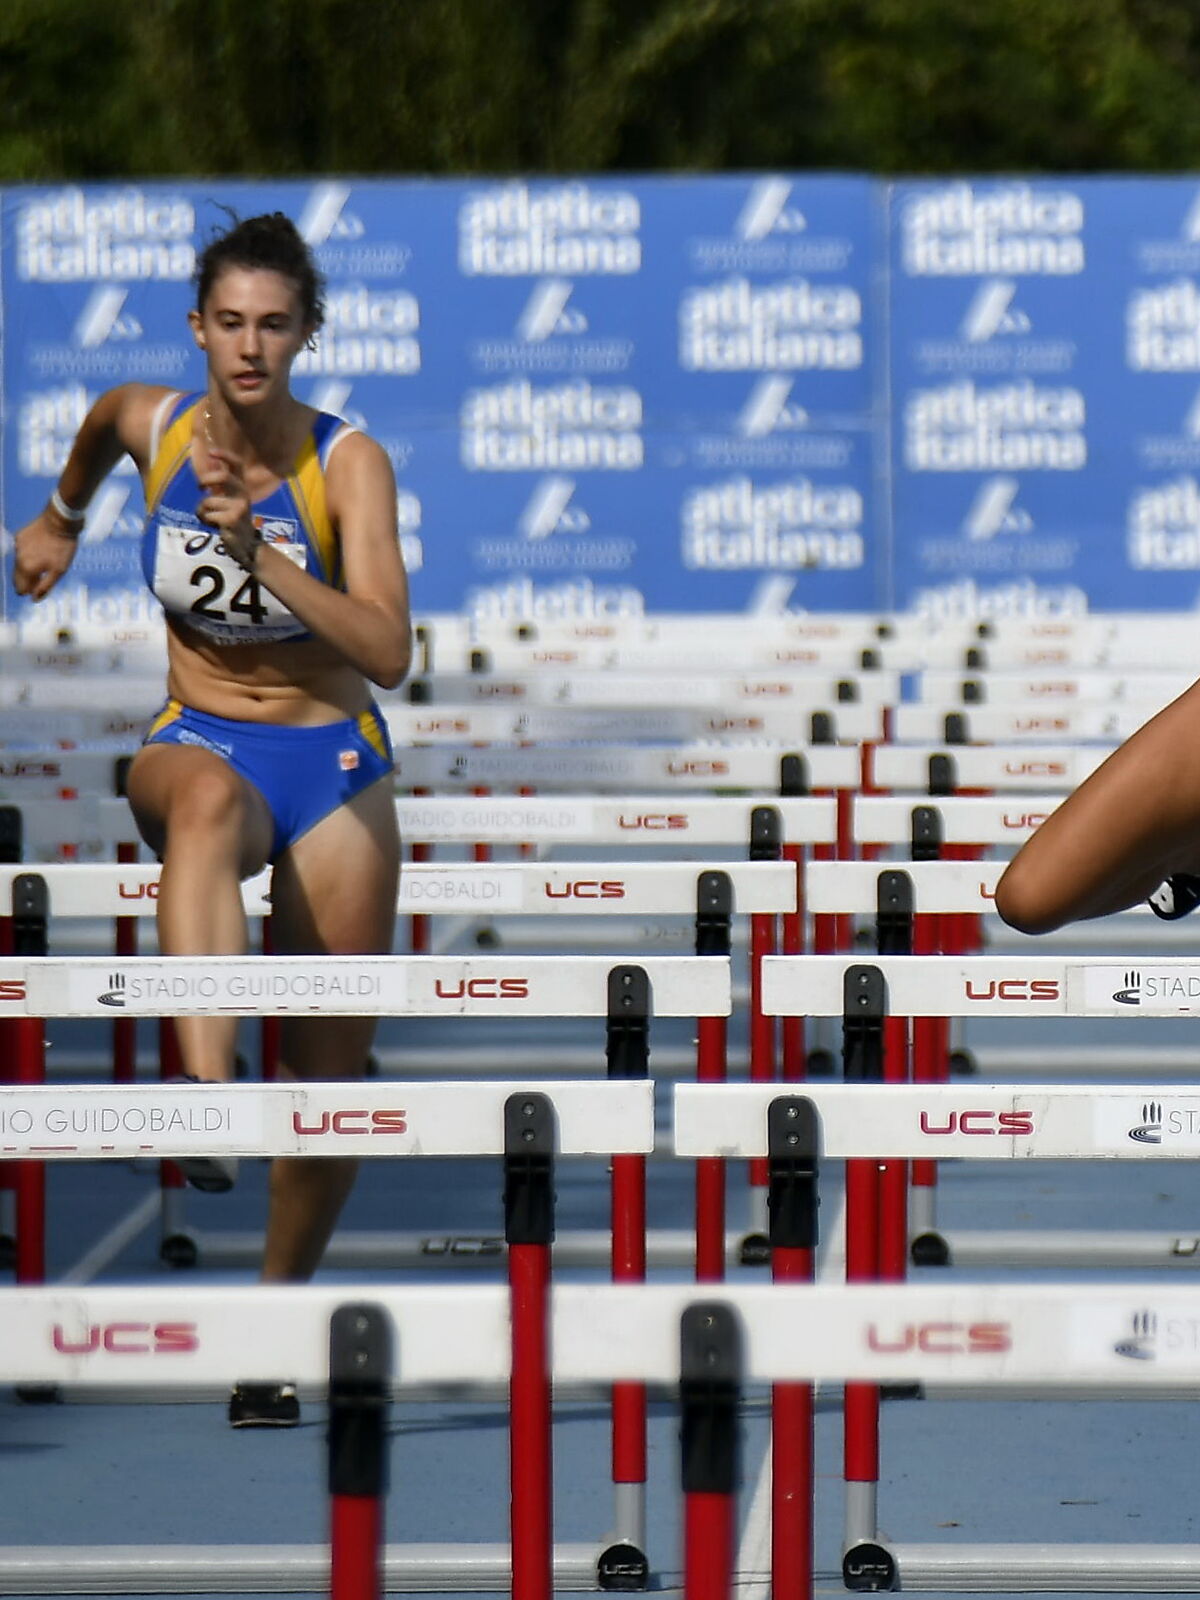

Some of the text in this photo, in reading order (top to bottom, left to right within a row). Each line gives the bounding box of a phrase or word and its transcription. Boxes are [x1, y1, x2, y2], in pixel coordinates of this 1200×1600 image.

[25, 188, 195, 237] atletica
[467, 183, 641, 232] atletica
[911, 181, 1084, 230] atletica
[26, 230, 195, 279] italiana
[468, 225, 641, 273] italiana
[912, 223, 1084, 273] italiana
[690, 276, 861, 325] atletica
[691, 318, 861, 368] italiana
[469, 378, 643, 427] atletica
[914, 378, 1086, 427] atletica
[470, 420, 643, 468] italiana
[915, 420, 1086, 468] italiana
[691, 476, 863, 525] atletica
[692, 518, 863, 567] italiana
[190, 565, 269, 625] 24
[667, 762, 730, 776] UCS
[1005, 762, 1068, 777] UCS
[618, 814, 689, 831] UCS
[1002, 813, 1048, 830] UC
[545, 880, 626, 900] UCS
[130, 974, 381, 998] STADIO GUIDOBALDI
[435, 979, 530, 1000] UCS
[965, 980, 1061, 1001] UCS
[45, 1106, 231, 1134] GUIDOBALDI
[292, 1110, 408, 1136] UCS
[919, 1110, 1035, 1137] UCS
[51, 1321, 200, 1357] UCS
[866, 1321, 1012, 1356] UCS
